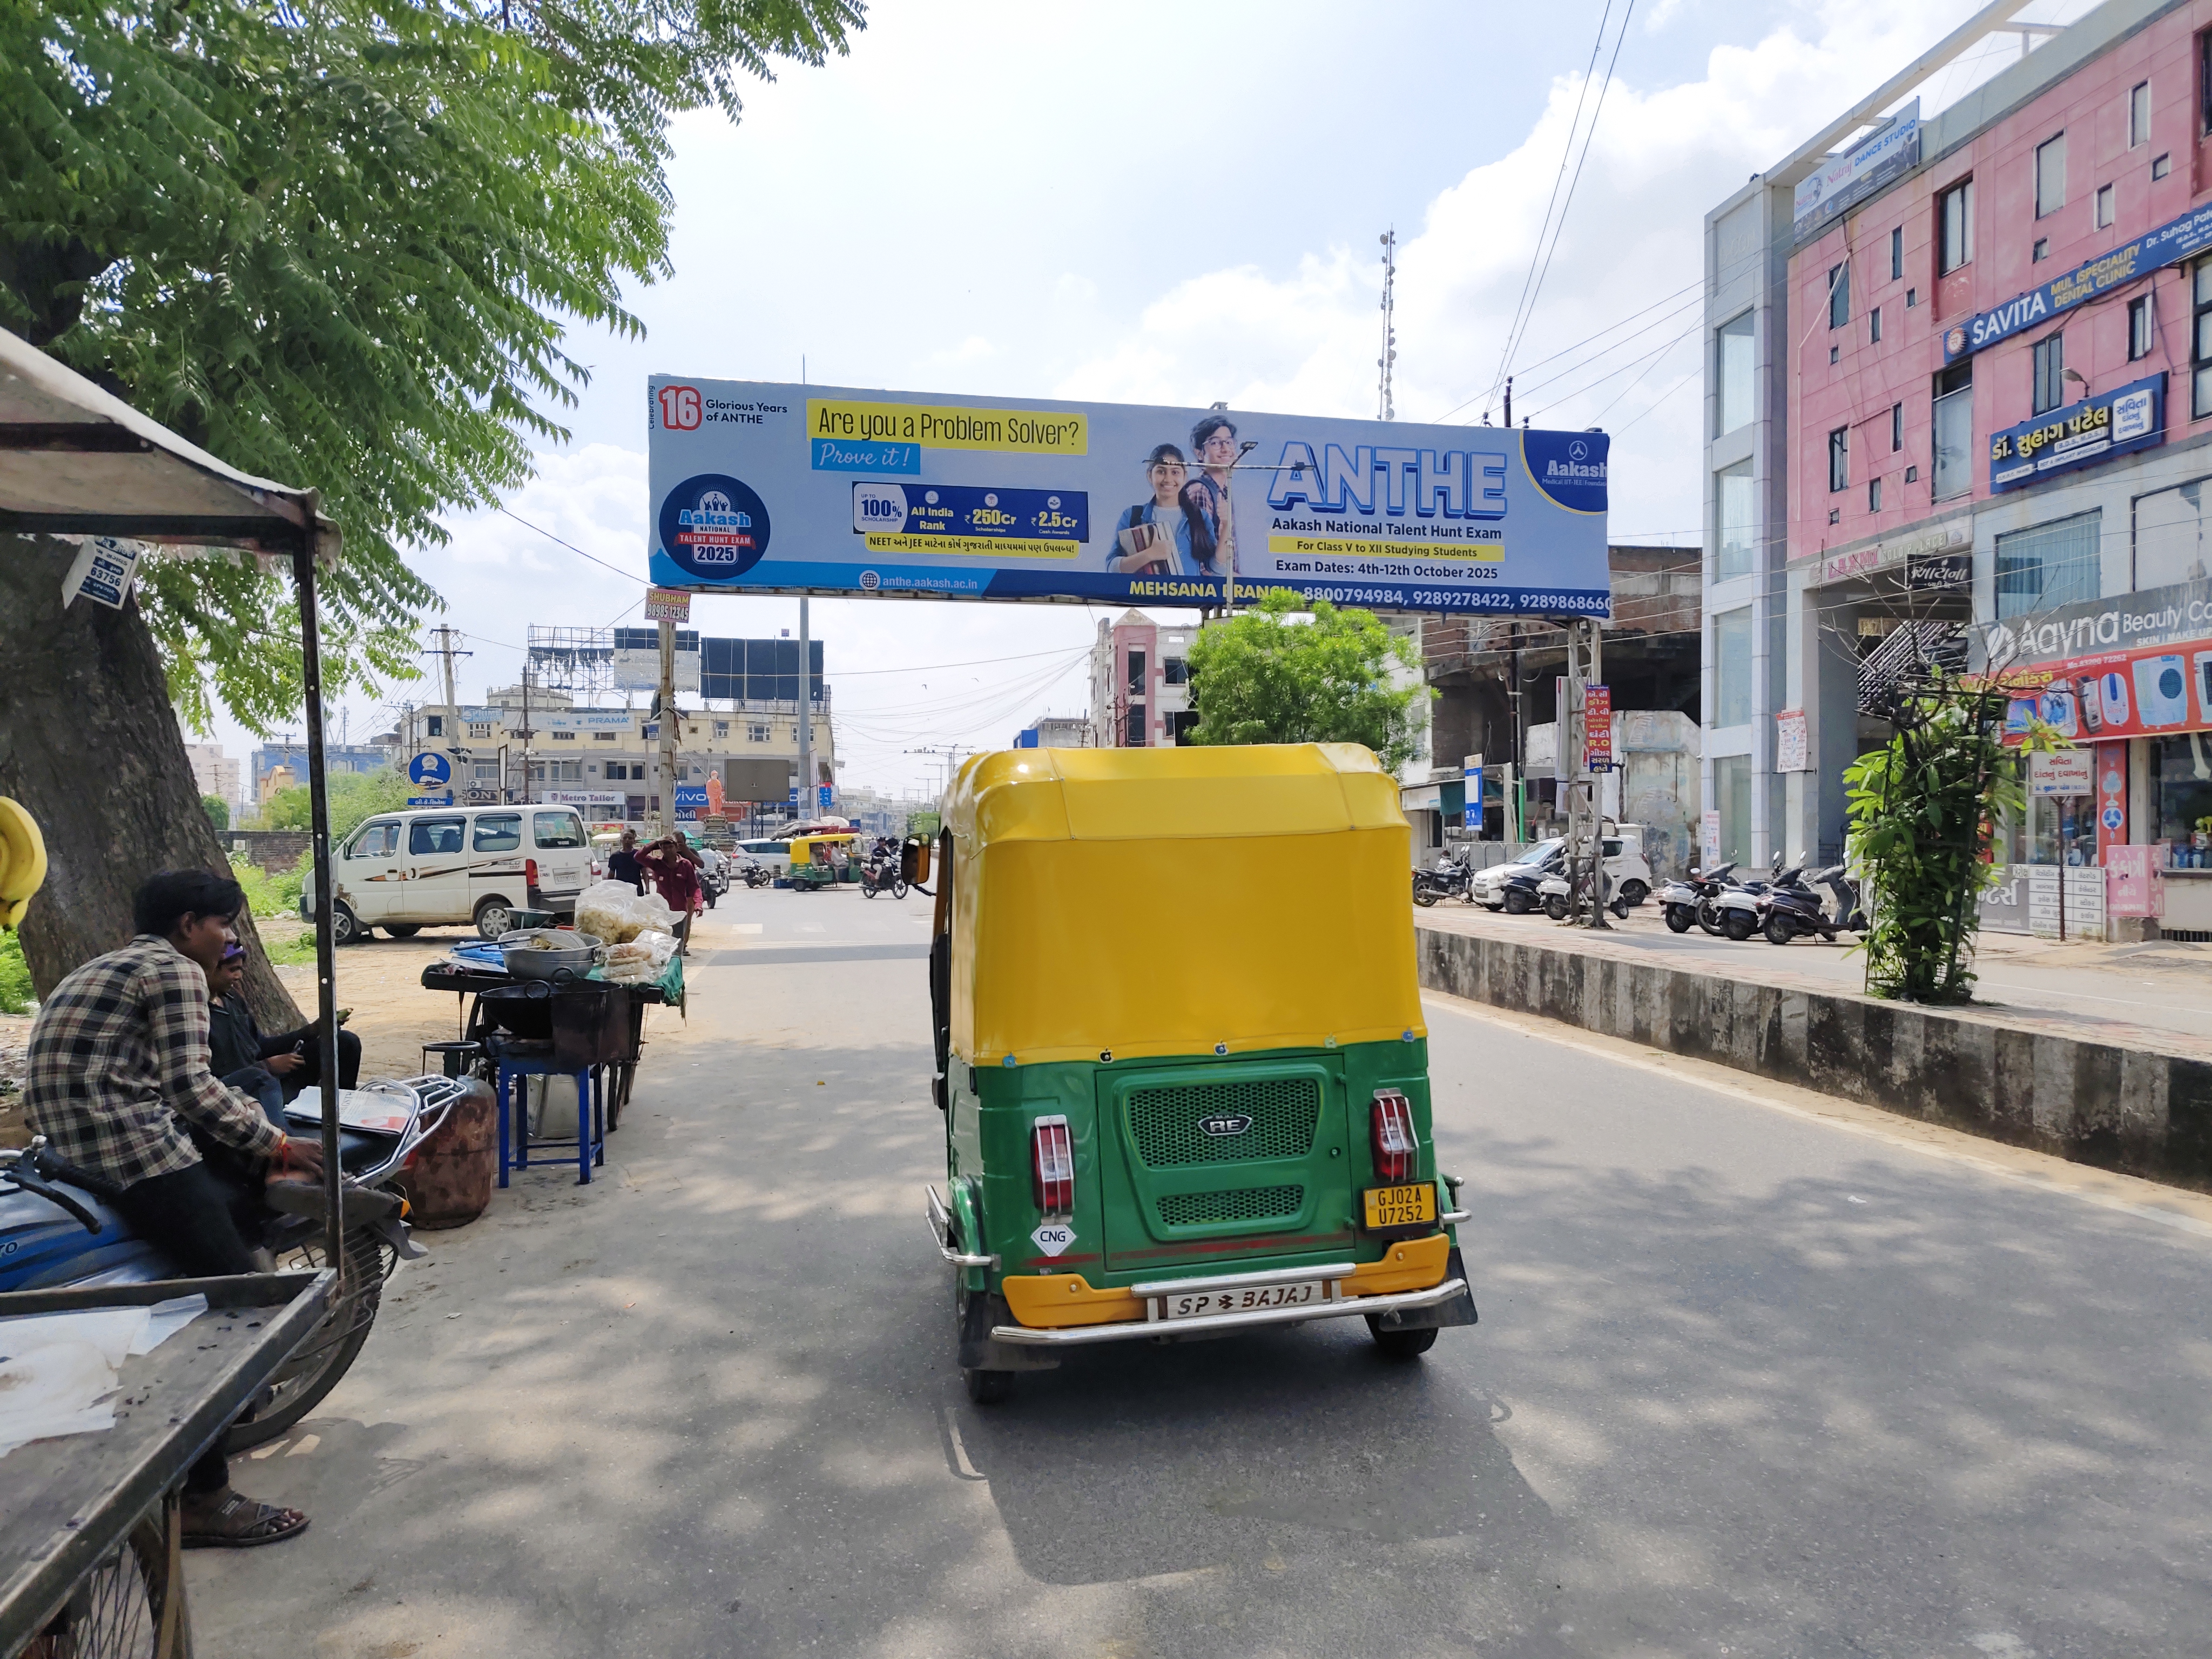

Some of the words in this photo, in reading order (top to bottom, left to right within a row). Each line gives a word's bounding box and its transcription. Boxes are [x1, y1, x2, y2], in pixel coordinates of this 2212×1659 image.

[1854, 141, 1883, 167] DANCE
[1884, 119, 1916, 146] STUDIO
[2161, 220, 2193, 241] Suhag
[2054, 282, 2094, 308] DENTAL
[2096, 261, 2136, 288] CLINIC
[1972, 292, 2046, 345] SAVITA
[659, 386, 702, 430] 16
[706, 399, 754, 411] Glorious
[756, 402, 788, 413] Years
[706, 412, 719, 421] of
[721, 413, 764, 424] ANTHE
[819, 407, 854, 433] Are
[860, 413, 896, 441] you
[903, 417, 914, 437] a
[921, 414, 1001, 441] Problem
[1008, 418, 1079, 446] Solver?
[2017, 422, 2063, 458] સુહાગ
[2067, 404, 2108, 433] પટેલ
[819, 442, 877, 466] Prove
[881, 448, 900, 466] it
[1547, 460, 1607, 477] Aakash
[1266, 440, 1508, 520] ANTHE
[679, 509, 751, 527] Aakash
[911, 507, 925, 516] All
[928, 508, 954, 518] India
[920, 521, 946, 531] Rank
[1272, 518, 1321, 531] Aakash
[1326, 521, 1382, 534] National
[1386, 523, 1427, 536] Talent
[1431, 525, 1462, 538] Hunt
[1466, 527, 1502, 539] Exam
[680, 535, 706, 543] TALENT
[869, 537, 892, 546] NEET
[893, 536, 908, 547] અને
[909, 538, 922, 549] JEE
[925, 537, 946, 548] માટેના
[963, 540, 993, 552] ગુજરાતી
[995, 542, 1026, 551] માધ્યમમાં
[1028, 545, 1042, 554] પણ
[697, 546, 734, 561] 2025
[1297, 541, 1314, 550] For
[1317, 542, 1343, 552] Class
[1345, 543, 1352, 552] V
[1355, 544, 1366, 553] to
[1369, 545, 1382, 554] XII
[1385, 545, 1429, 556] Studying
[1433, 547, 1478, 557] Students
[1276, 560, 1311, 572] Exam
[1315, 562, 1354, 574] Dates:
[1358, 563, 1410, 577] 4th-12th
[1413, 565, 1464, 578] October
[1467, 568, 1498, 579] 2025
[1827, 549, 1878, 578] LAXMI
[91, 567, 122, 586] 63756
[882, 577, 978, 589] anthe.aakash.ac.in
[649, 592, 689, 605] SHUBHAM
[1129, 581, 1217, 597] MEHSANA
[1413, 591, 1514, 609] 9289278422,
[1520, 594, 1610, 610] 9289868660
[648, 603, 669, 618] 98985
[669, 605, 689, 621] 12345
[2020, 611, 2119, 659] Aayna
[2123, 605, 2182, 633] Beauty
[2136, 635, 2160, 647] SKIN
[2168, 629, 2196, 641] MAKE
[2049, 756, 2072, 765] સવિતા
[1210, 1120, 1240, 1132] RE
[1378, 1187, 1421, 1206] GJ02A
[1379, 1205, 1423, 1224] U7252
[1040, 1231, 1065, 1242] CNG
[1178, 1297, 1209, 1315] SP
[1242, 1286, 1312, 1308] BAJAJ
